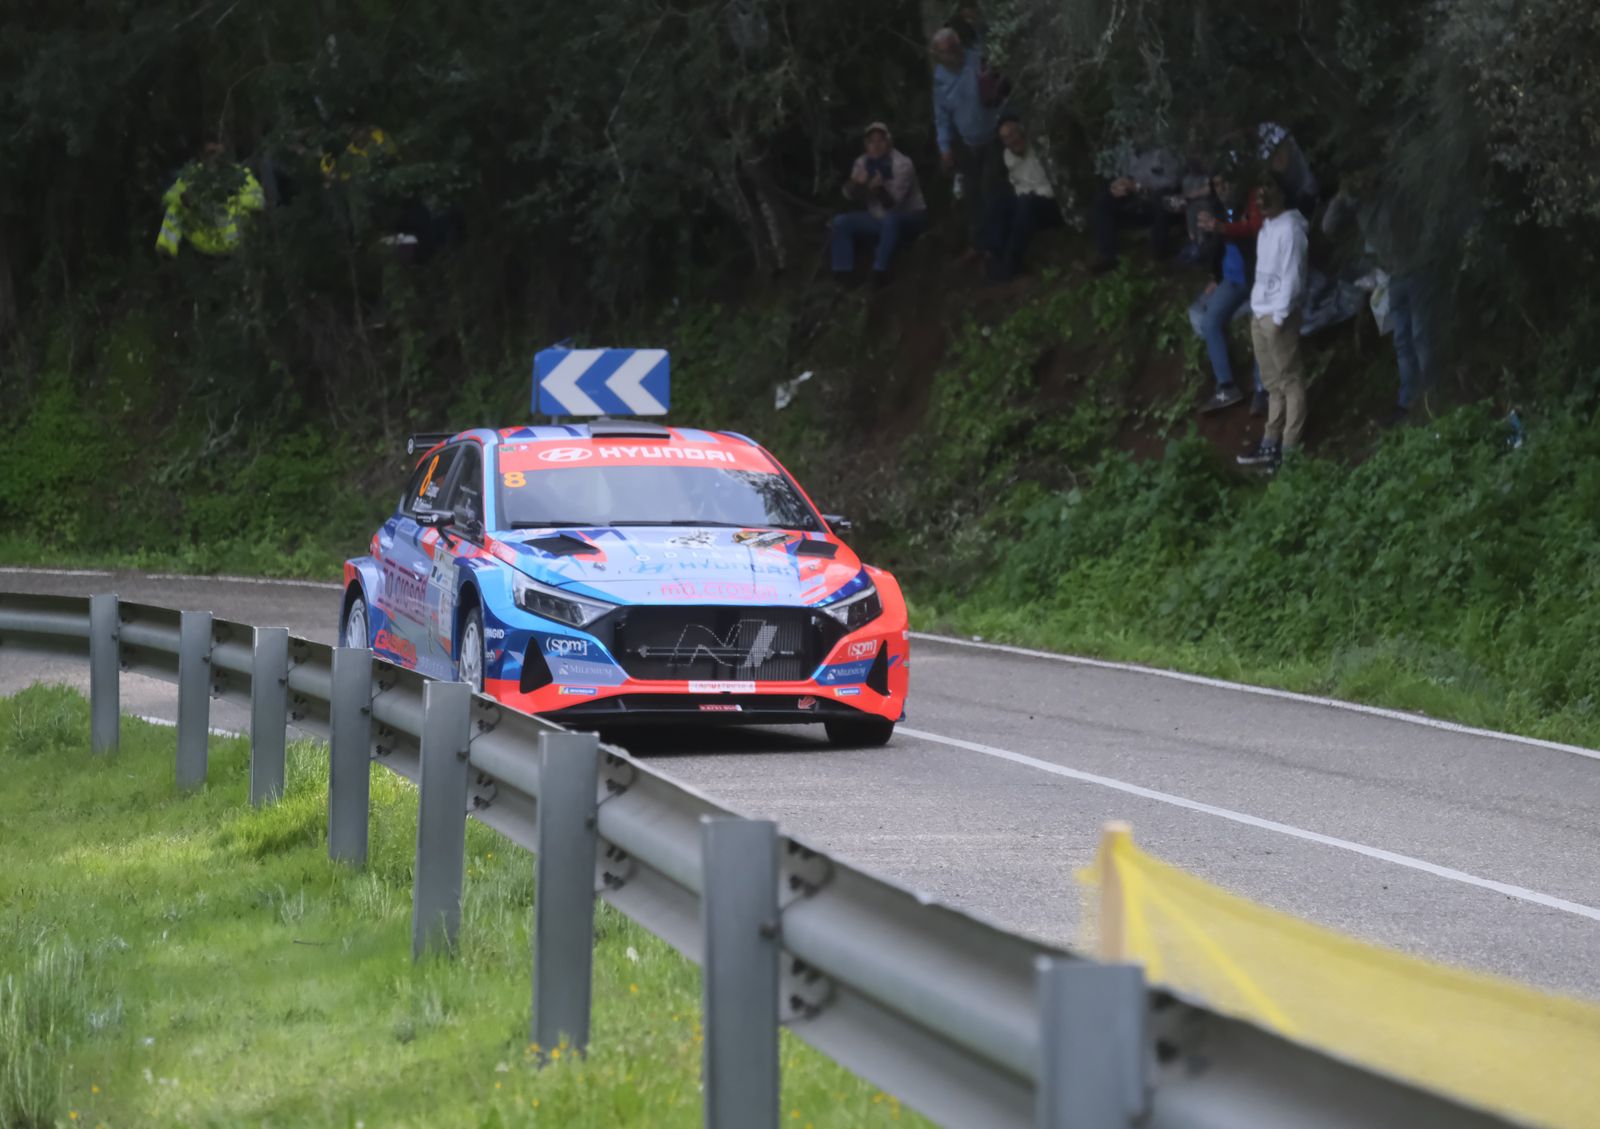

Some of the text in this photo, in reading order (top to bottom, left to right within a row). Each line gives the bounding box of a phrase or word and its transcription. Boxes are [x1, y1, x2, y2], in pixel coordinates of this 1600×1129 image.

[600, 446, 735, 463] HYUNDAI
[419, 454, 440, 497] 8
[503, 471, 527, 488] 8
